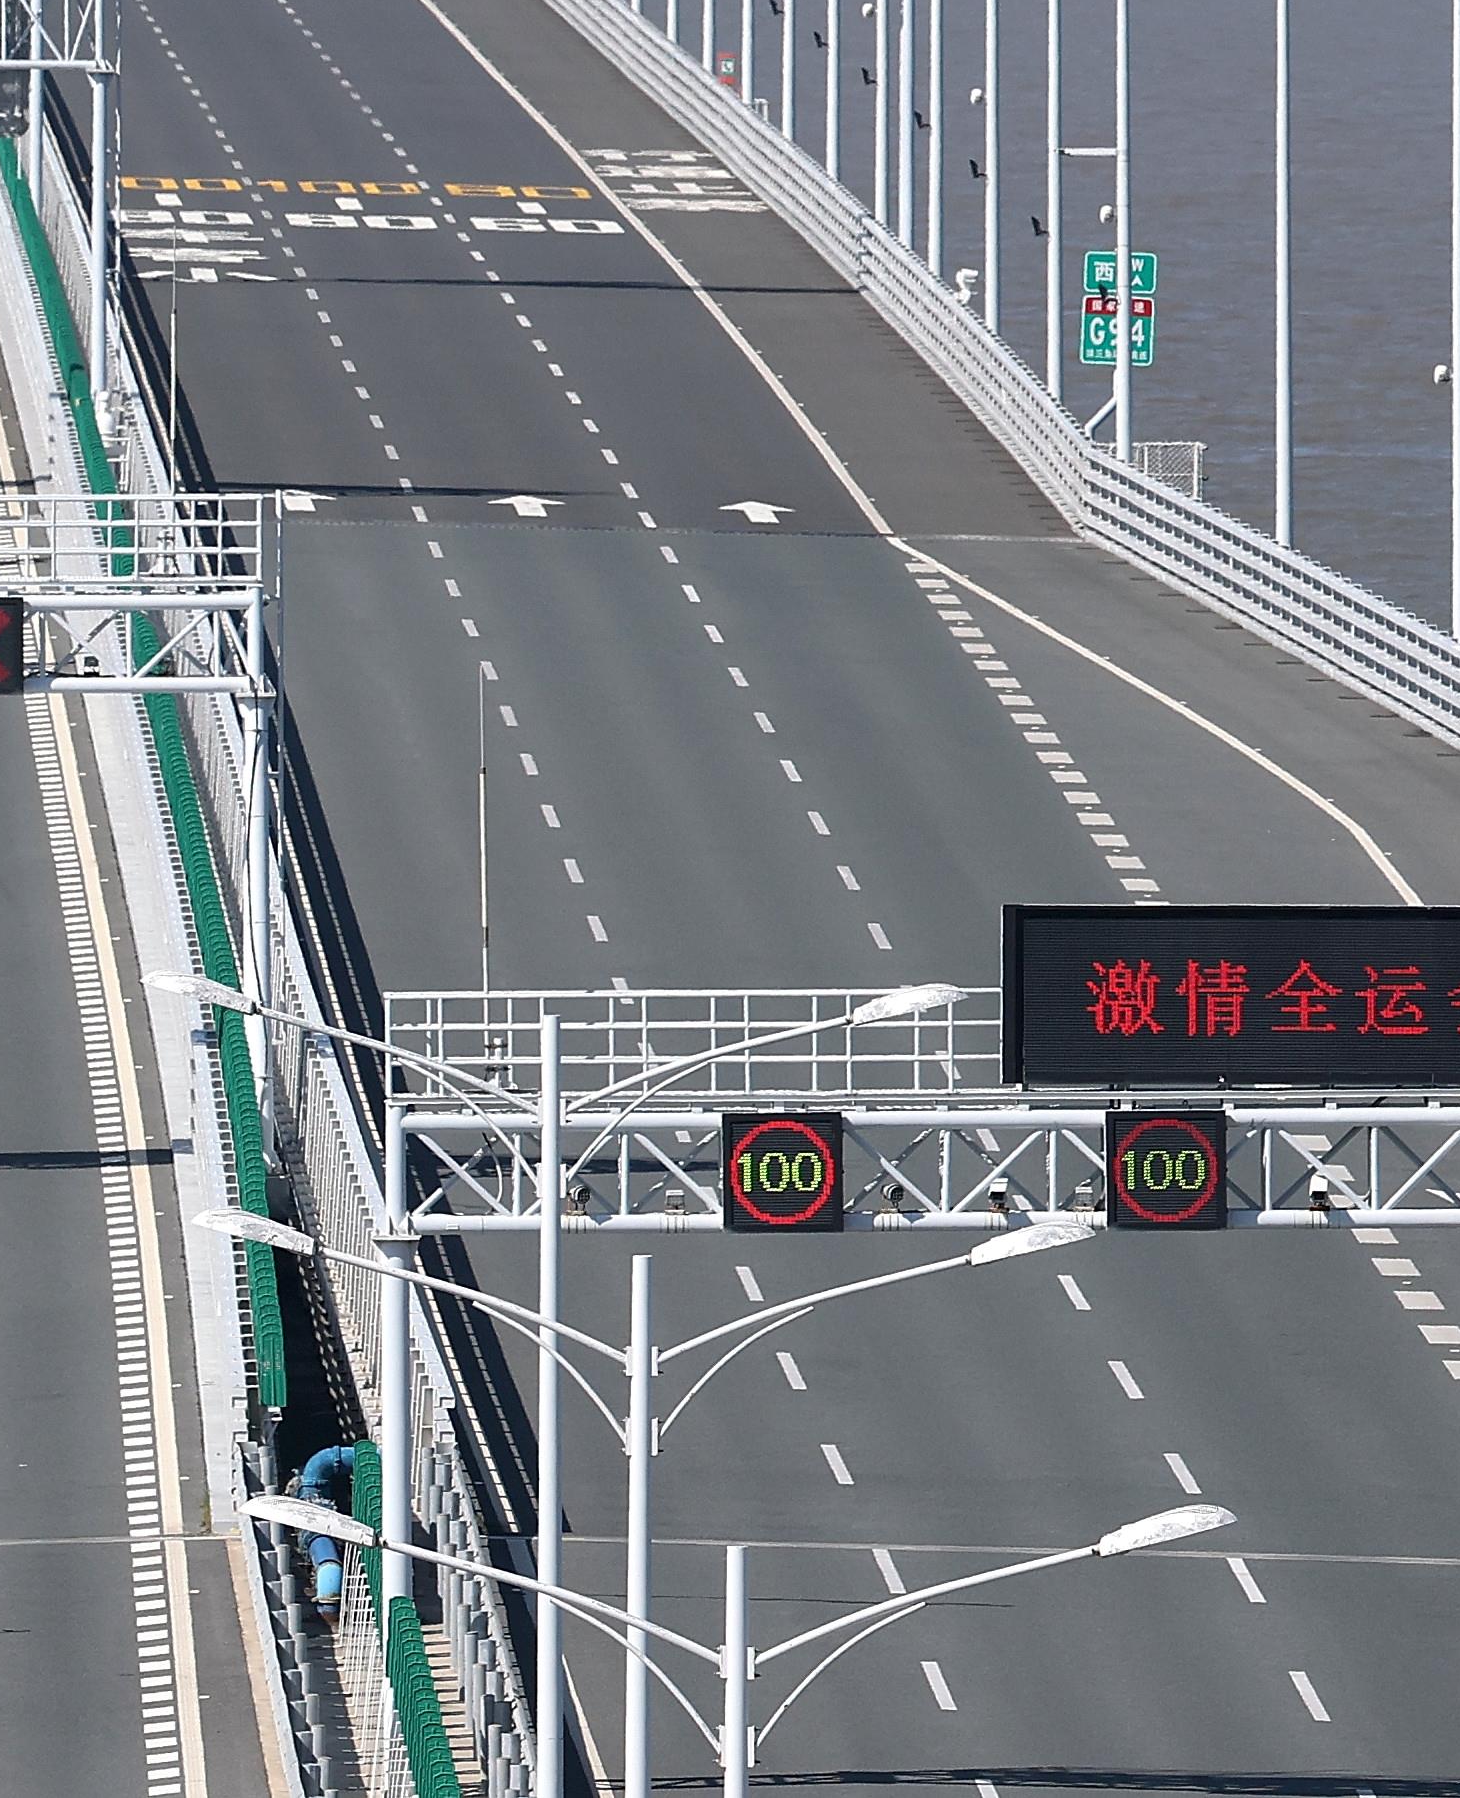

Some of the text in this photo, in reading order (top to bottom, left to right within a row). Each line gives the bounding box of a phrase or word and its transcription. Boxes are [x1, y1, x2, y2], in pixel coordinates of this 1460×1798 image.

[1093, 258, 1145, 282] 西 W
[736, 1150, 824, 1192] 100
[1121, 1150, 1206, 1191] 100
